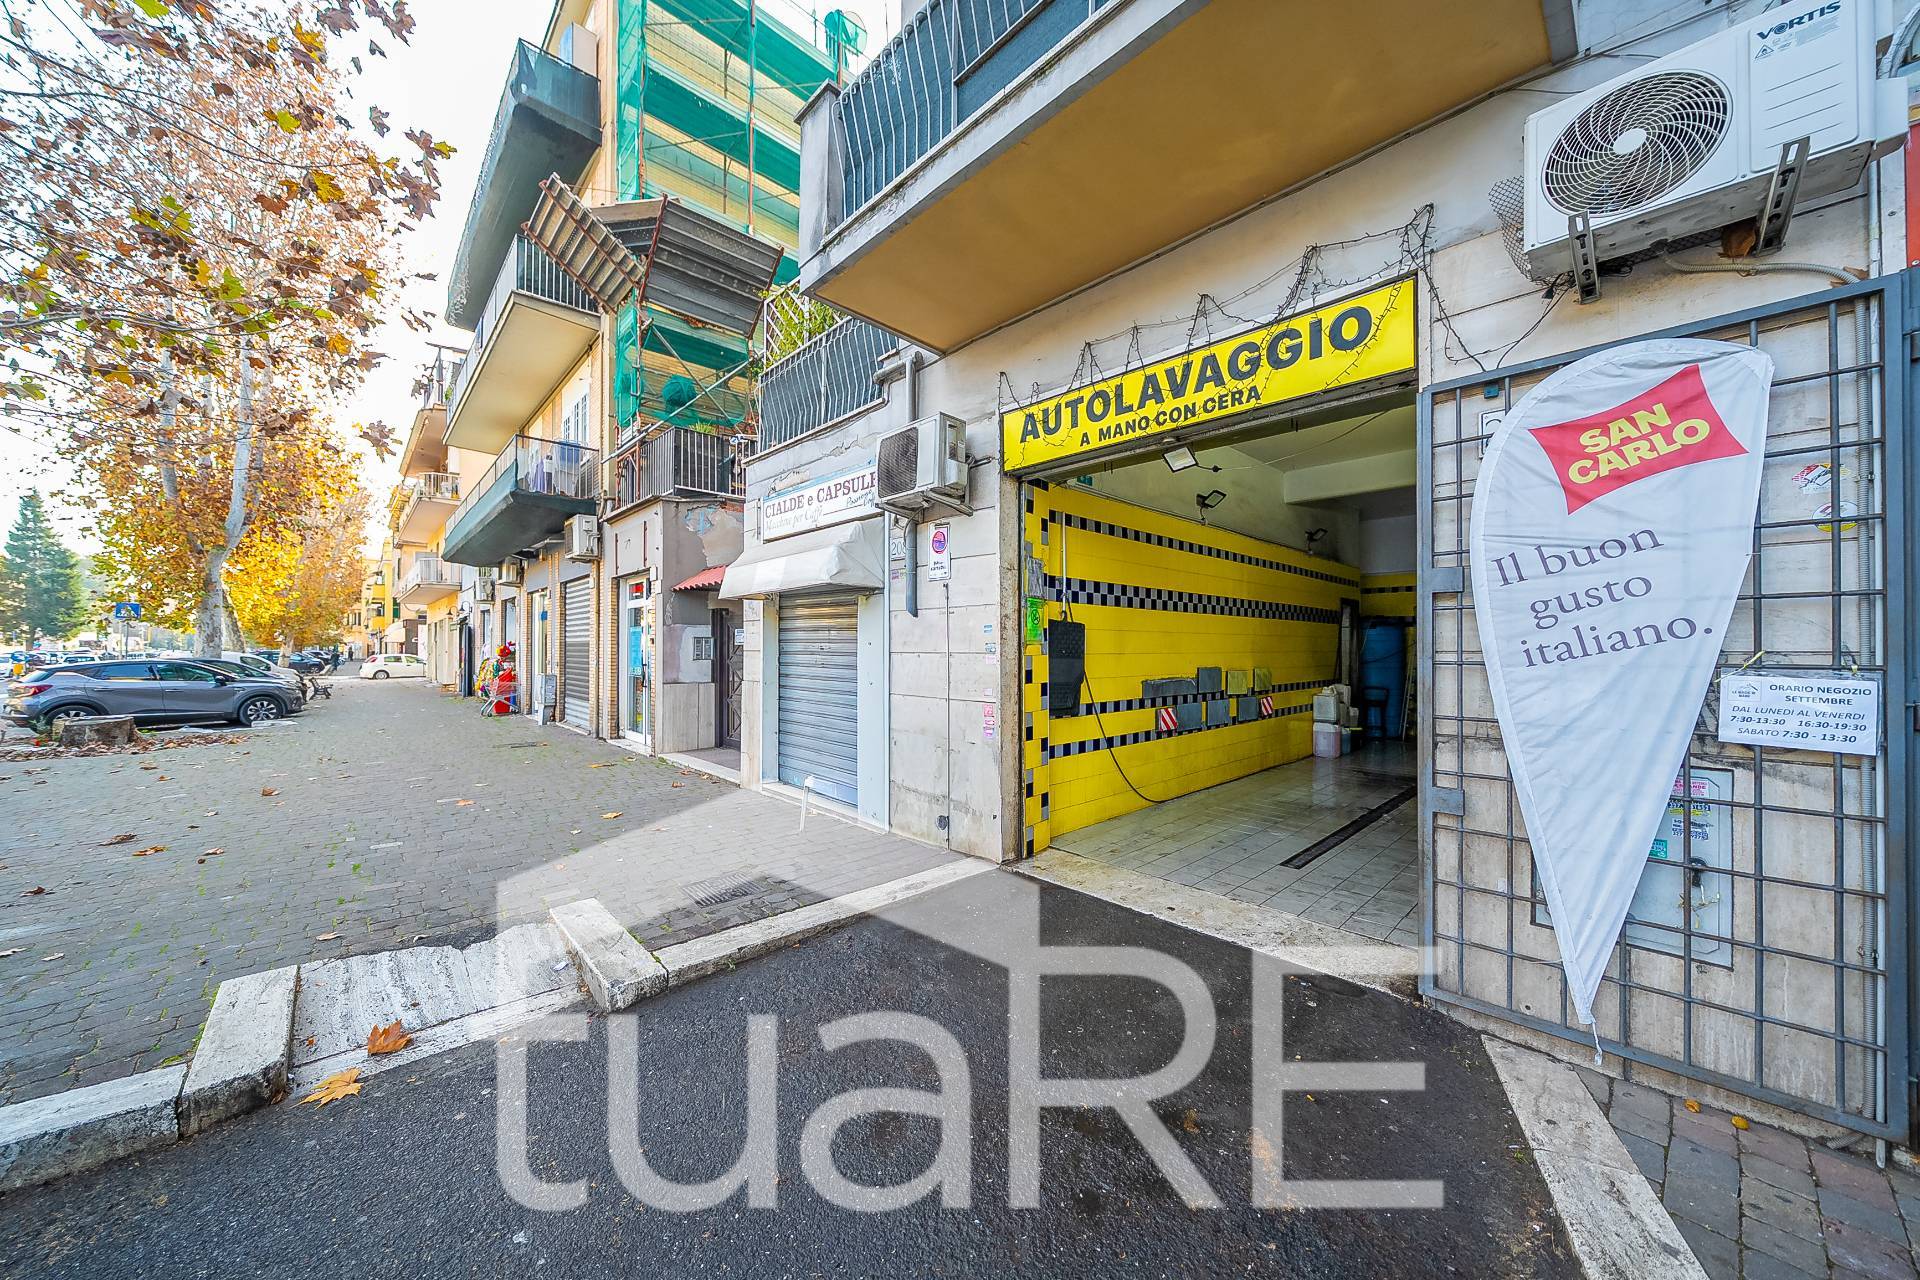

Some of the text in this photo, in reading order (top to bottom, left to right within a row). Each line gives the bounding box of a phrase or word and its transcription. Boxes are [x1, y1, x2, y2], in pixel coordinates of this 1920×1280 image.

[1756, 1, 1841, 40] VORTIS
[1020, 306, 1373, 443] AUTOLAVAGGIO
[1080, 385, 1261, 447] A MANO CON CERA
[1579, 402, 1672, 454] SAN
[1568, 418, 1711, 484] CARLO
[765, 494, 805, 519] CIALDE
[807, 495, 814, 506] e
[1491, 527, 1665, 587] Il buon
[1529, 575, 1652, 630] gusto
[1520, 616, 1713, 668] italiano.
[1732, 705, 1866, 720] DAL LUNEDI AL VENERDI
[1769, 684, 1872, 696] ORARIO NEGOZIO
[1784, 695, 1854, 706] SETTEMBRE
[1730, 715, 1867, 732] 7:30-13:30 16:30-19:30
[1737, 727, 1780, 737] SABATO
[1782, 730, 1810, 739] 7:30
[1820, 733, 1857, 743] 13:30
